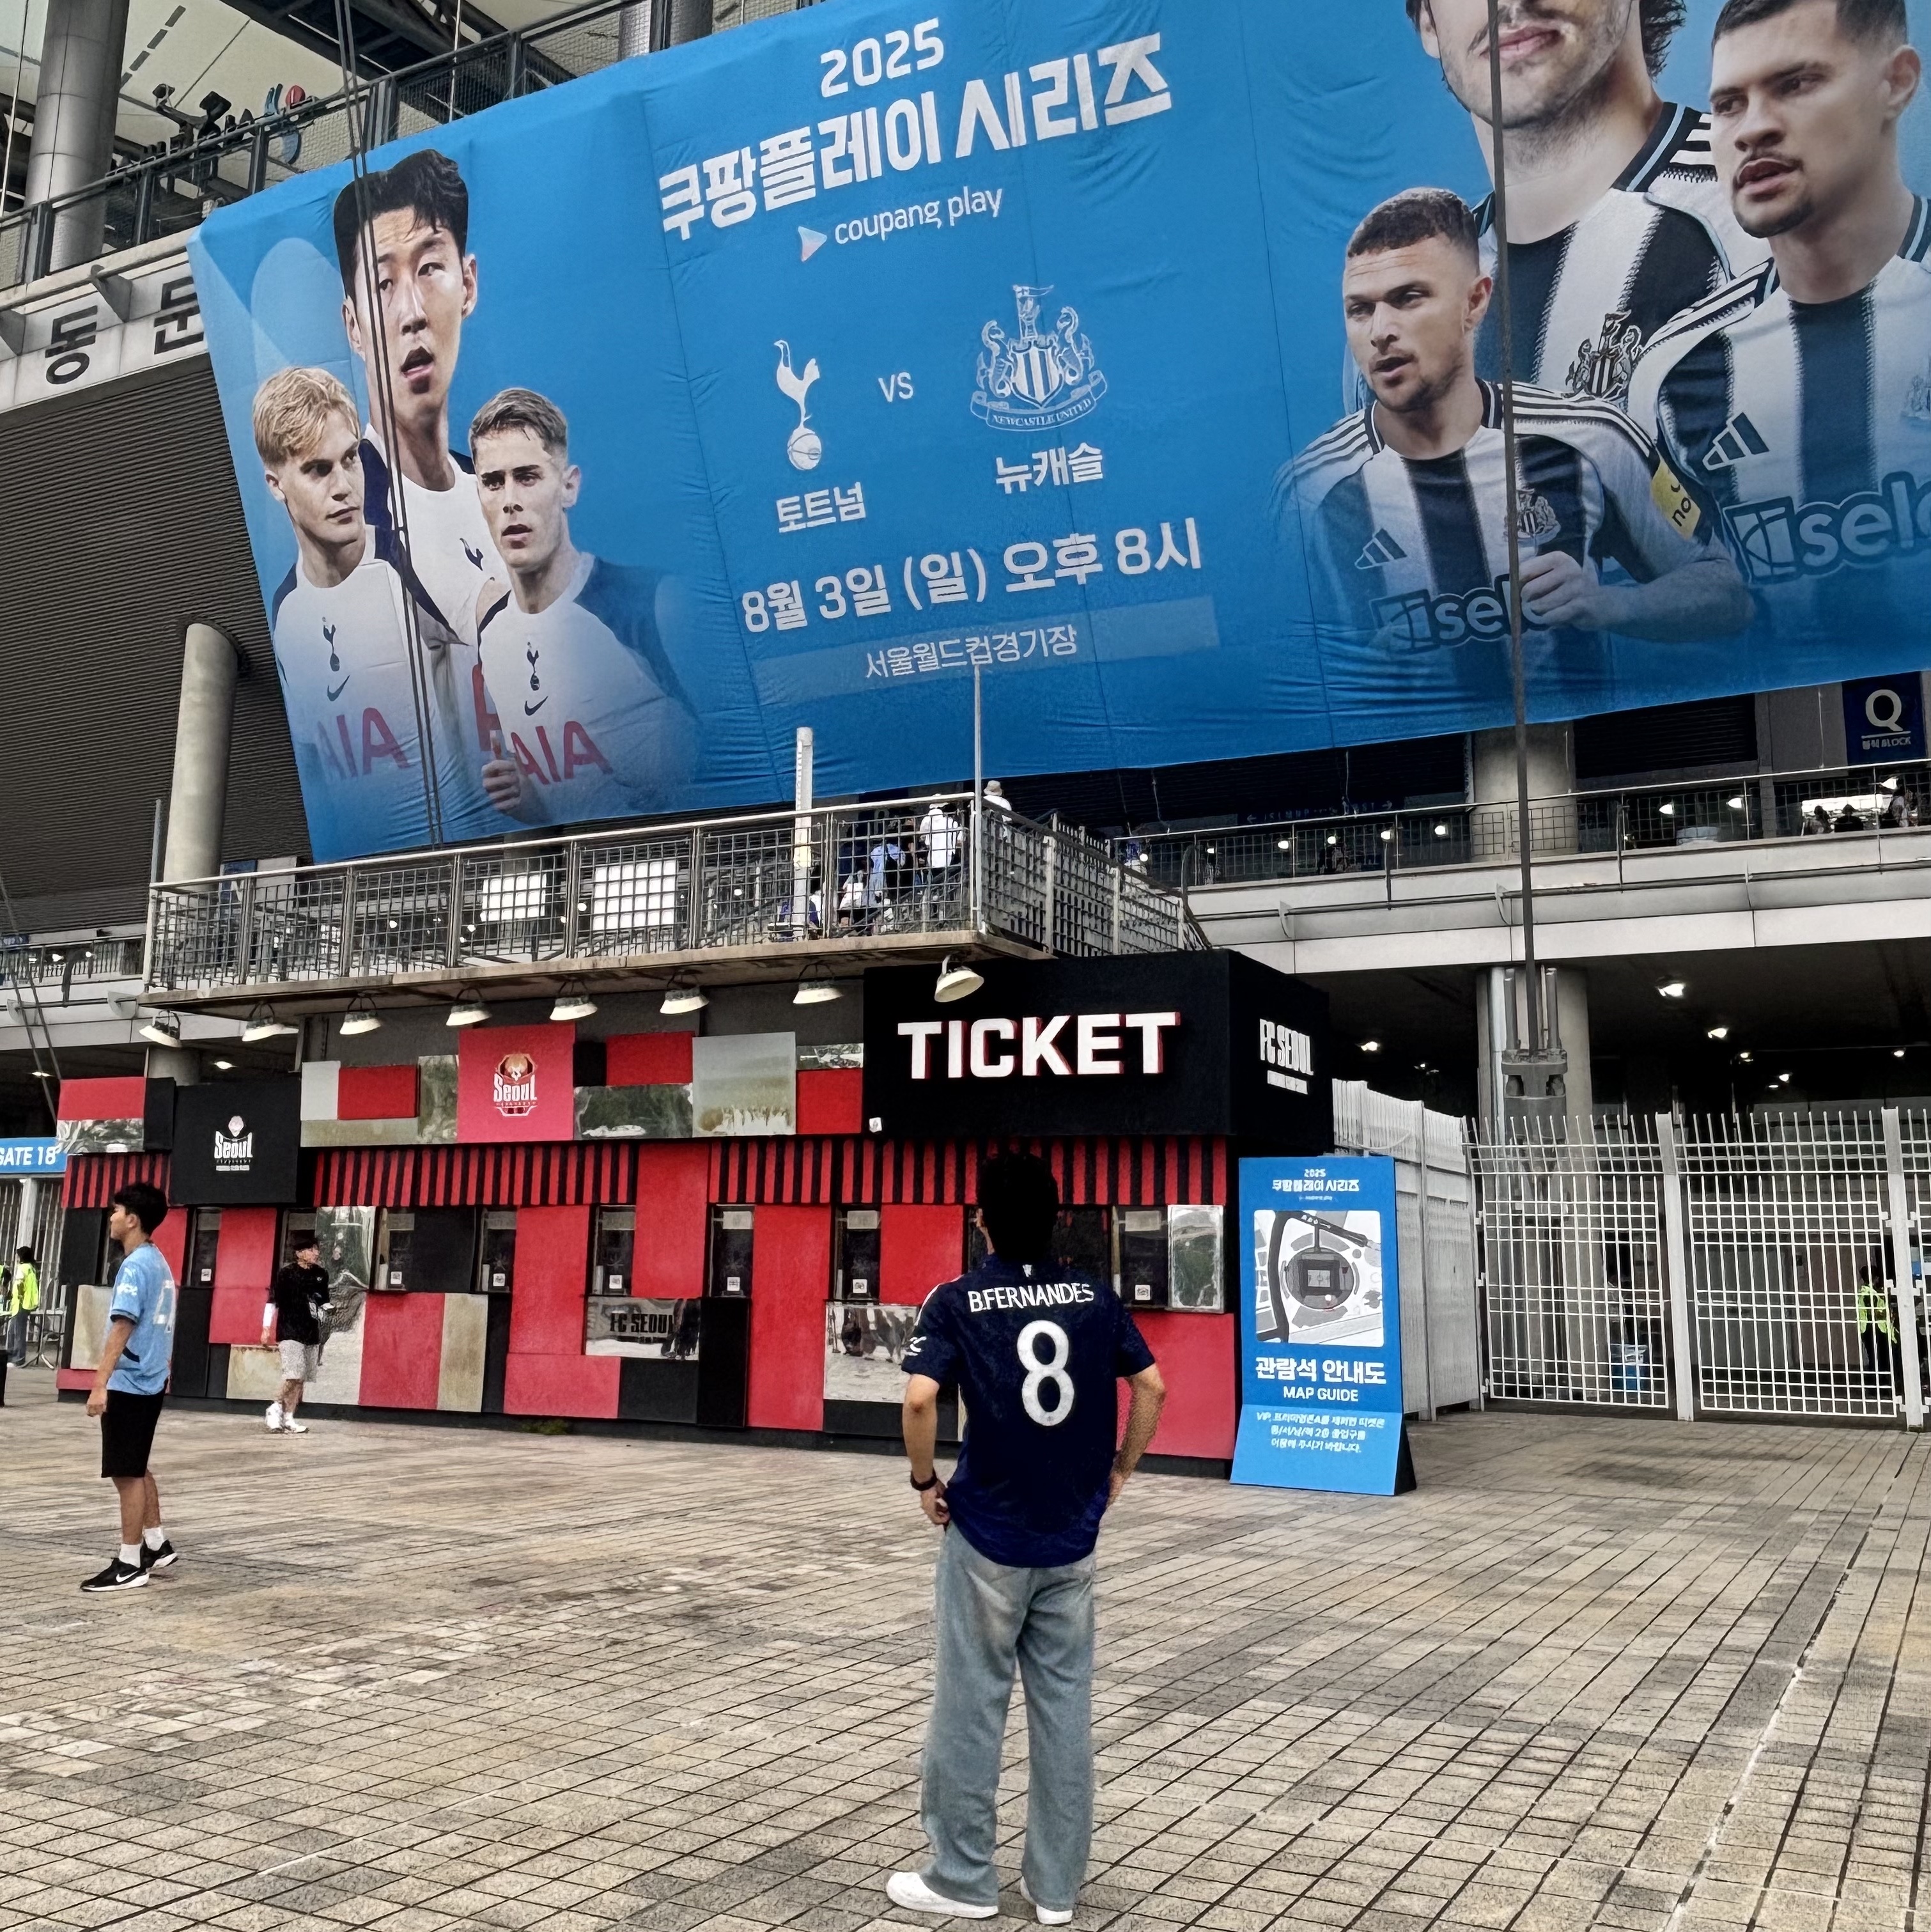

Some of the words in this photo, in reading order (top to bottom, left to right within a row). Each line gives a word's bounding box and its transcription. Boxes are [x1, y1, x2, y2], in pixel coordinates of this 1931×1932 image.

[820, 18, 945, 97] 2025
[660, 91, 941, 240] 쿠팡플레이
[956, 33, 1172, 159] 시리즈
[834, 199, 940, 245] coupang
[949, 186, 1002, 228] play
[992, 414, 1055, 426] NEWCASTLE
[1055, 398, 1092, 422] UNITED
[995, 442, 1103, 494] 뉴캐슬
[775, 481, 866, 533] 토트넘
[742, 580, 808, 634] 8월
[816, 564, 891, 619] 3일
[903, 547, 986, 611] (일)
[1003, 532, 1103, 593] 오후
[1115, 517, 1202, 575] 8시
[865, 624, 1078, 679] 서울월드컵경기장
[1865, 689, 1904, 731] Q
[511, 721, 614, 785] AIA
[897, 1011, 1181, 1079] TICKET
[493, 1073, 538, 1102] Seoul
[38, 1146, 56, 1165] 18
[214, 1130, 253, 1158] Seoul
[1017, 1320, 1075, 1426] 8
[1255, 1357, 1317, 1382] 관람석
[1322, 1359, 1387, 1384] 안내도
[1283, 1386, 1314, 1399] MAP
[1317, 1387, 1359, 1402] GUIDE
